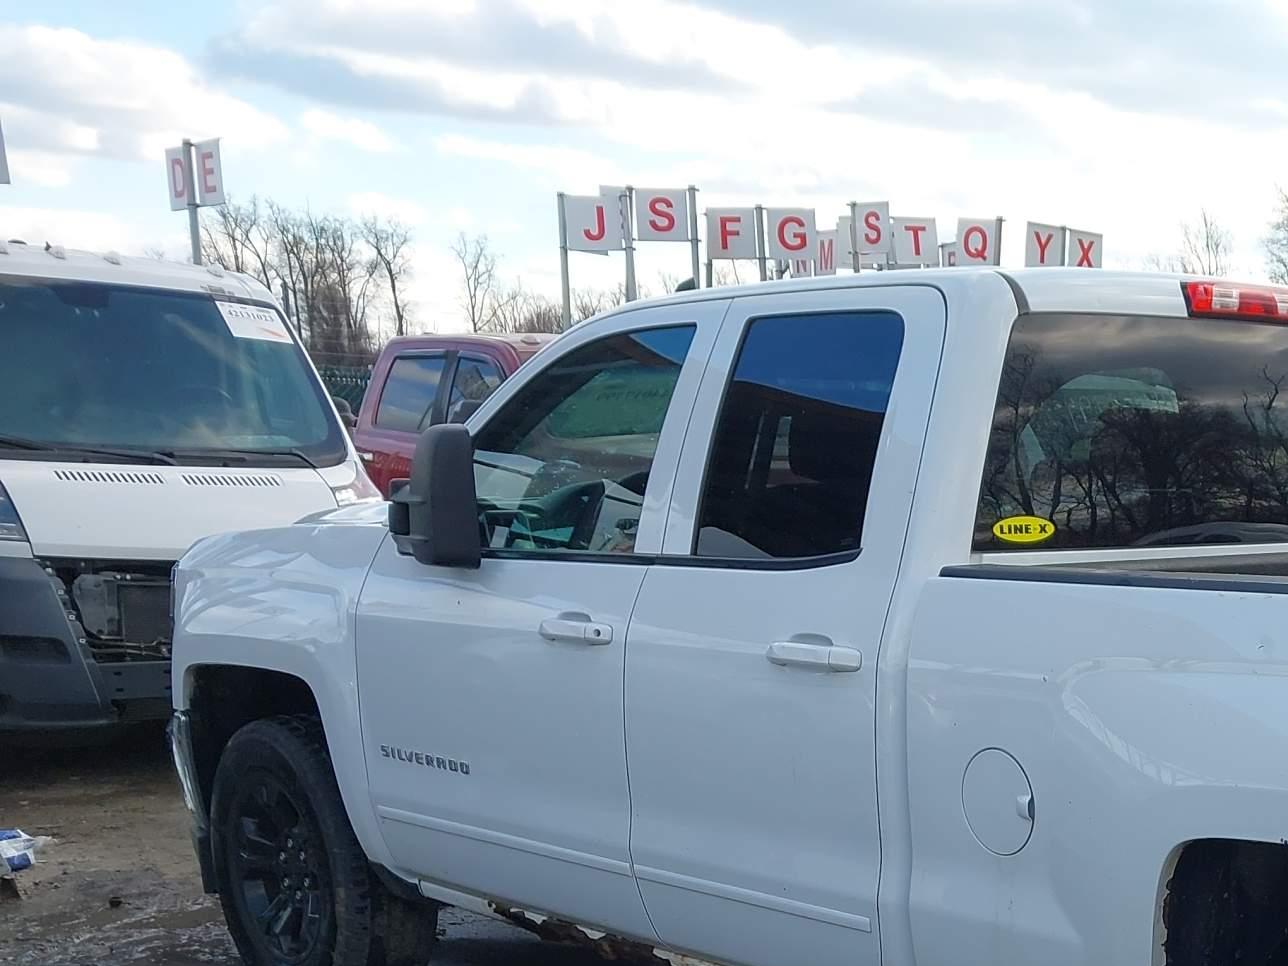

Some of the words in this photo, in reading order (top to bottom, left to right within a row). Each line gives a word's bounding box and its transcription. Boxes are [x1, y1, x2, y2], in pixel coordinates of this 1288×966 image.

[171, 158, 187, 199] D
[202, 151, 217, 194] E
[583, 205, 606, 241] J
[649, 196, 675, 232] S
[863, 210, 881, 245] S
[719, 216, 741, 250] F
[777, 215, 808, 251] G
[904, 225, 927, 256] T
[963, 225, 988, 262] Q
[1034, 231, 1054, 264] Y
[819, 239, 833, 271] M
[1077, 238, 1095, 267] X
[999, 523, 1049, 535] LINE-X
[379, 743, 471, 776] SILVERADO
